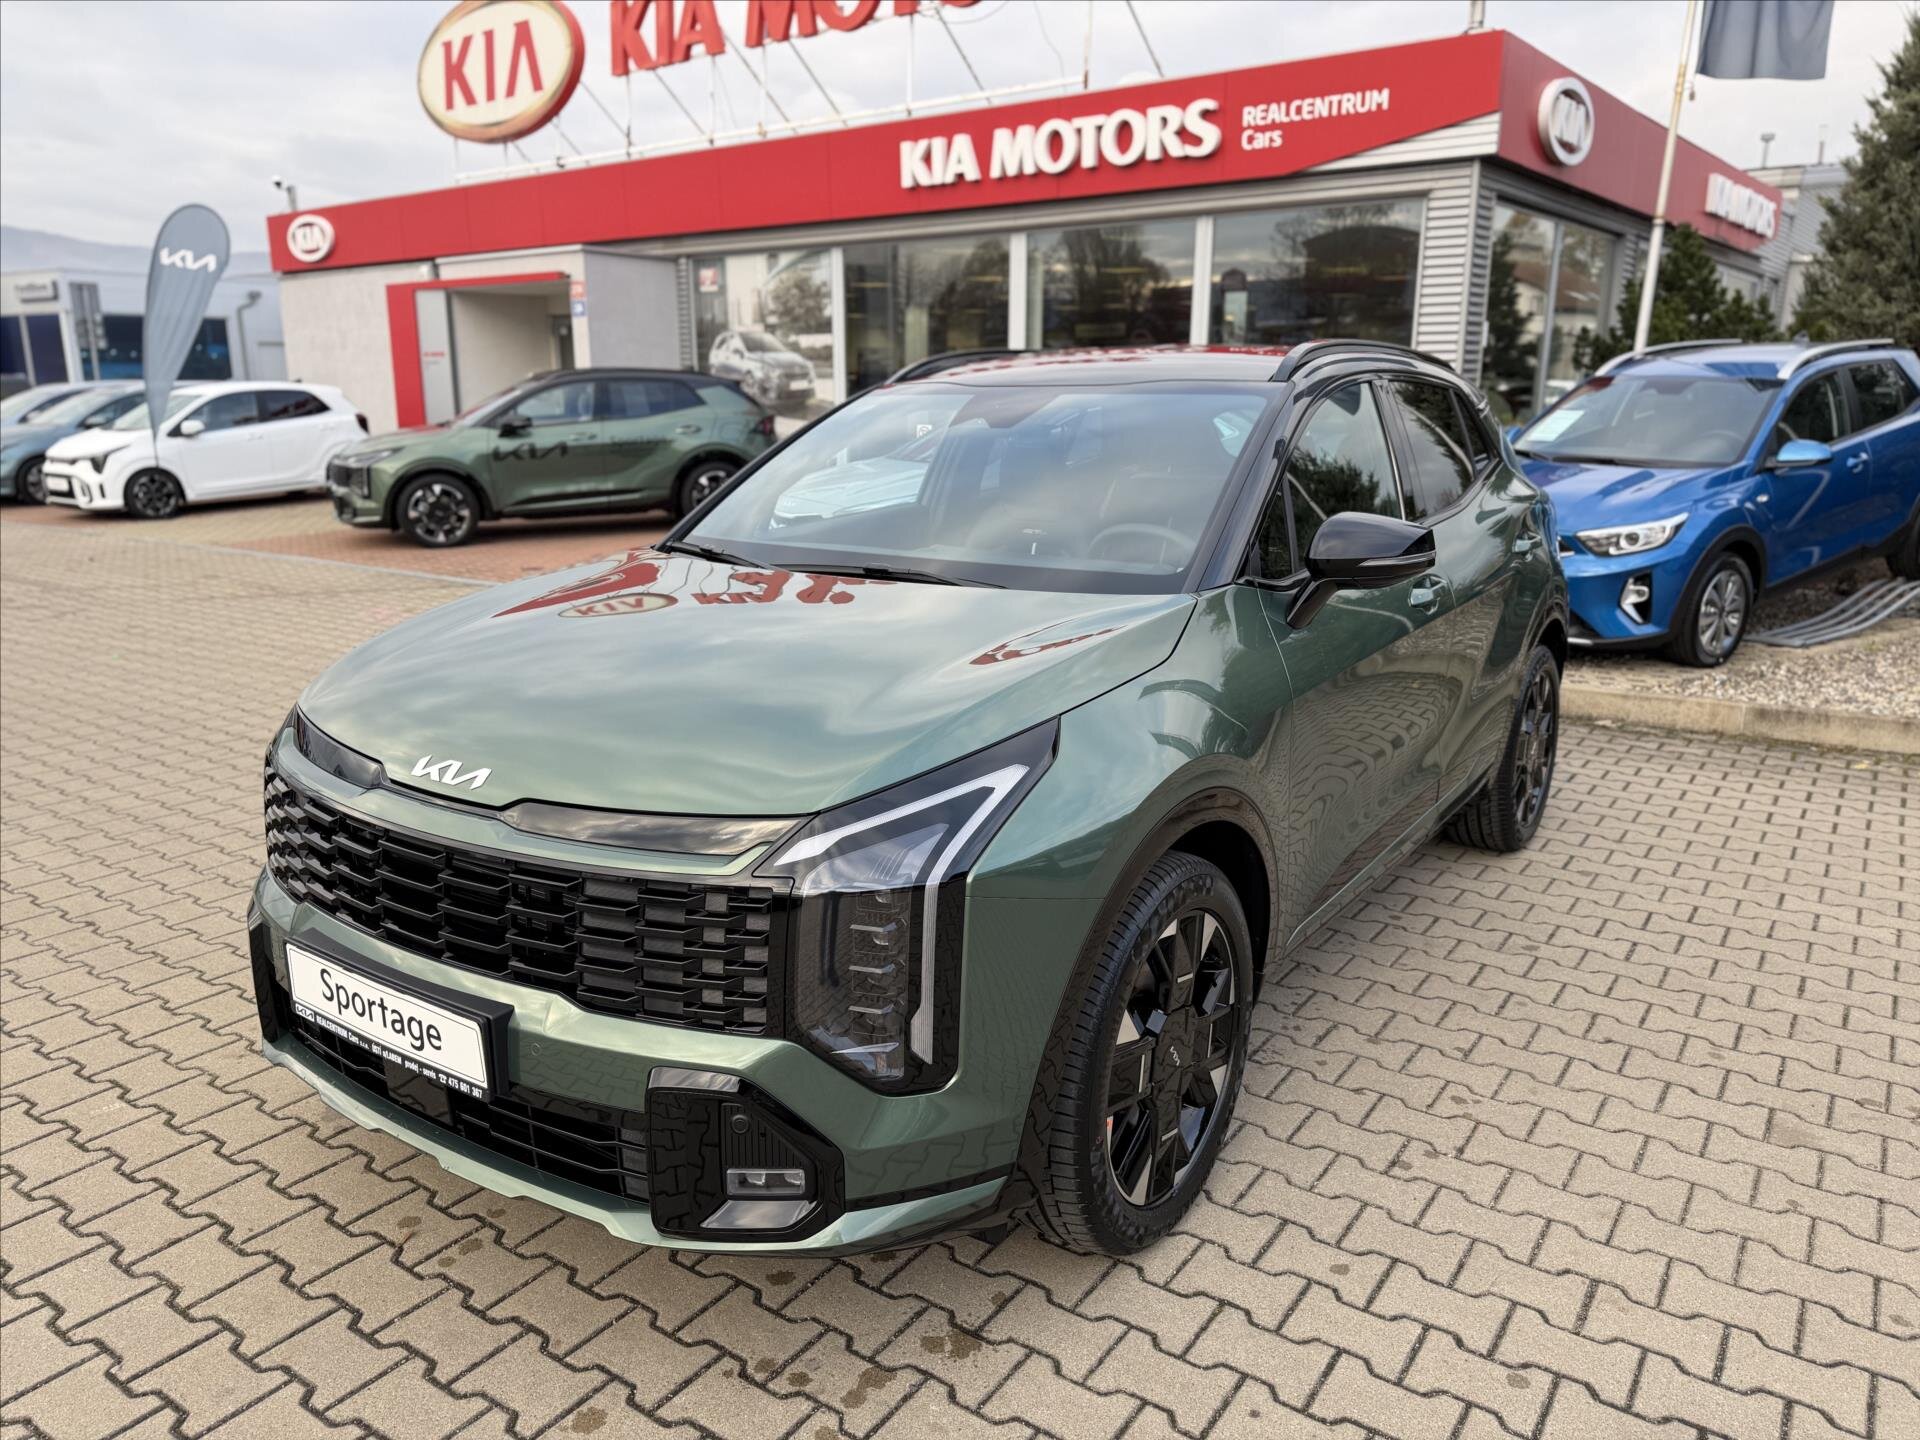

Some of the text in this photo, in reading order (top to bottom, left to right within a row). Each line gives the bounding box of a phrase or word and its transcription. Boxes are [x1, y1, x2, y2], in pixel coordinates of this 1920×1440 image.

[442, 20, 543, 111] KIA
[899, 98, 1222, 189] KIA MOTORS
[1241, 88, 1390, 150] REALCENTRUM Cars
[159, 247, 217, 273] KIA
[411, 754, 492, 790] KIA
[320, 968, 442, 1052] Sportage
[448, 1077, 459, 1089] 475
